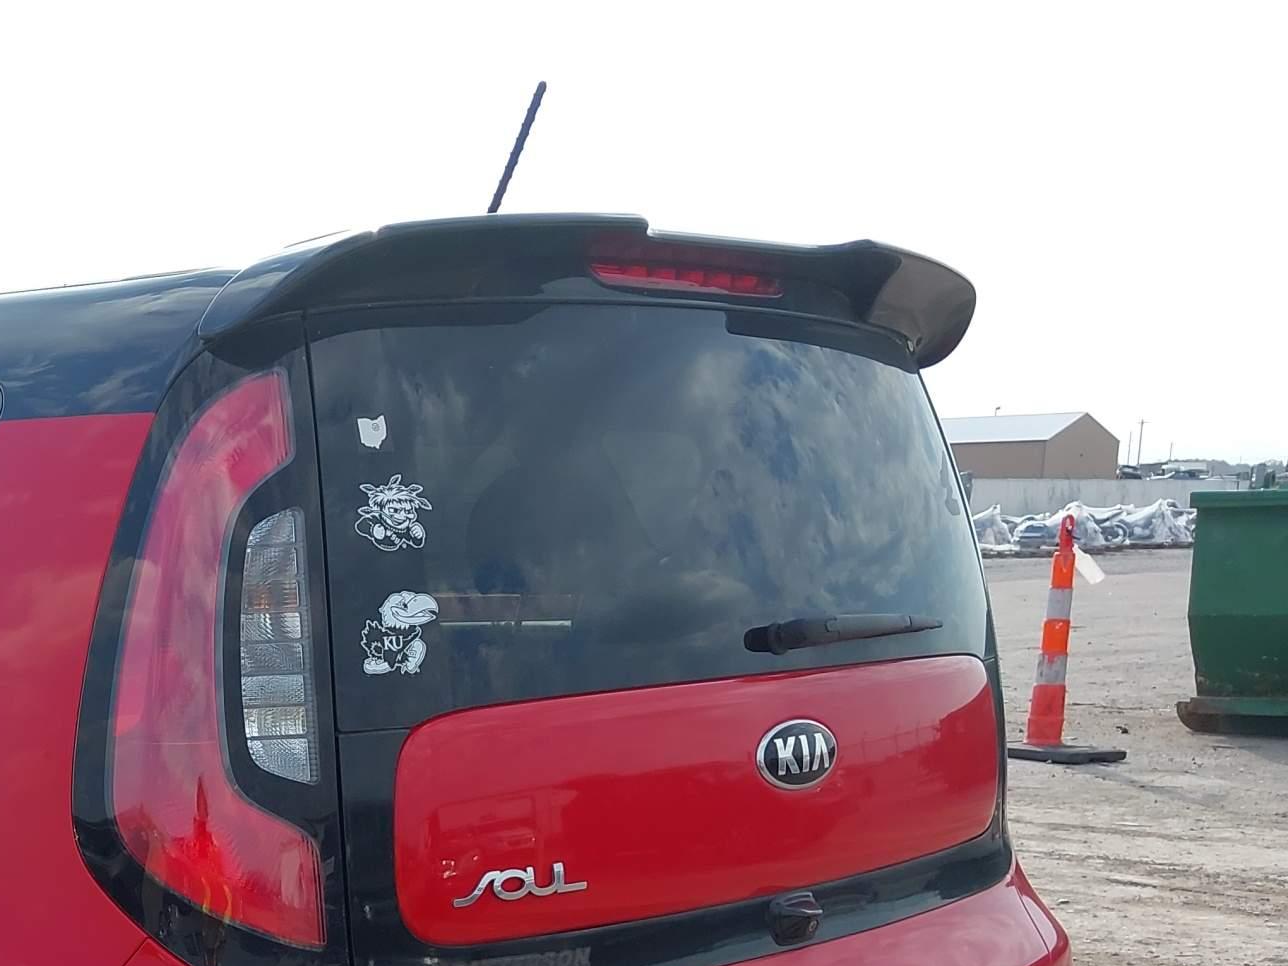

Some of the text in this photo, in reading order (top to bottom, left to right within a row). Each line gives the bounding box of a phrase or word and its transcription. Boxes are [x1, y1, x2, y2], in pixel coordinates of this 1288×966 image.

[382, 635, 404, 652] KU
[773, 732, 831, 777] KIA
[453, 861, 588, 908] SOUL
